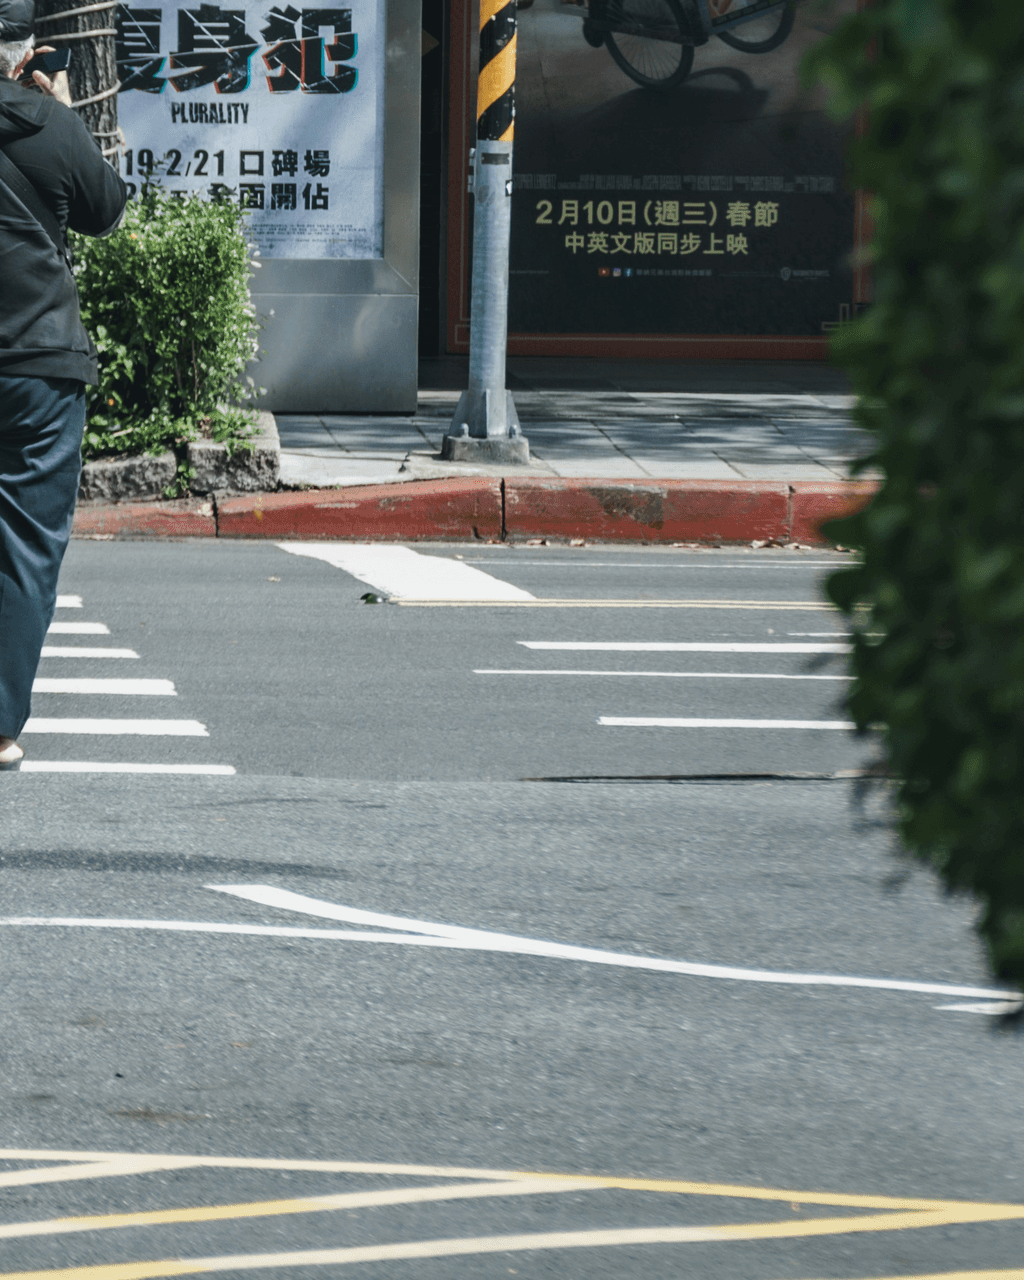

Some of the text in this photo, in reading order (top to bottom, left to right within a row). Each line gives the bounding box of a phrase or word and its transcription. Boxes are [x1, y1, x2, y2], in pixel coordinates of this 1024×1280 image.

[171, 101, 250, 124] PLURALITY
[239, 149, 331, 178] 口碑場
[564, 231, 749, 256] 中英文版同步上映
